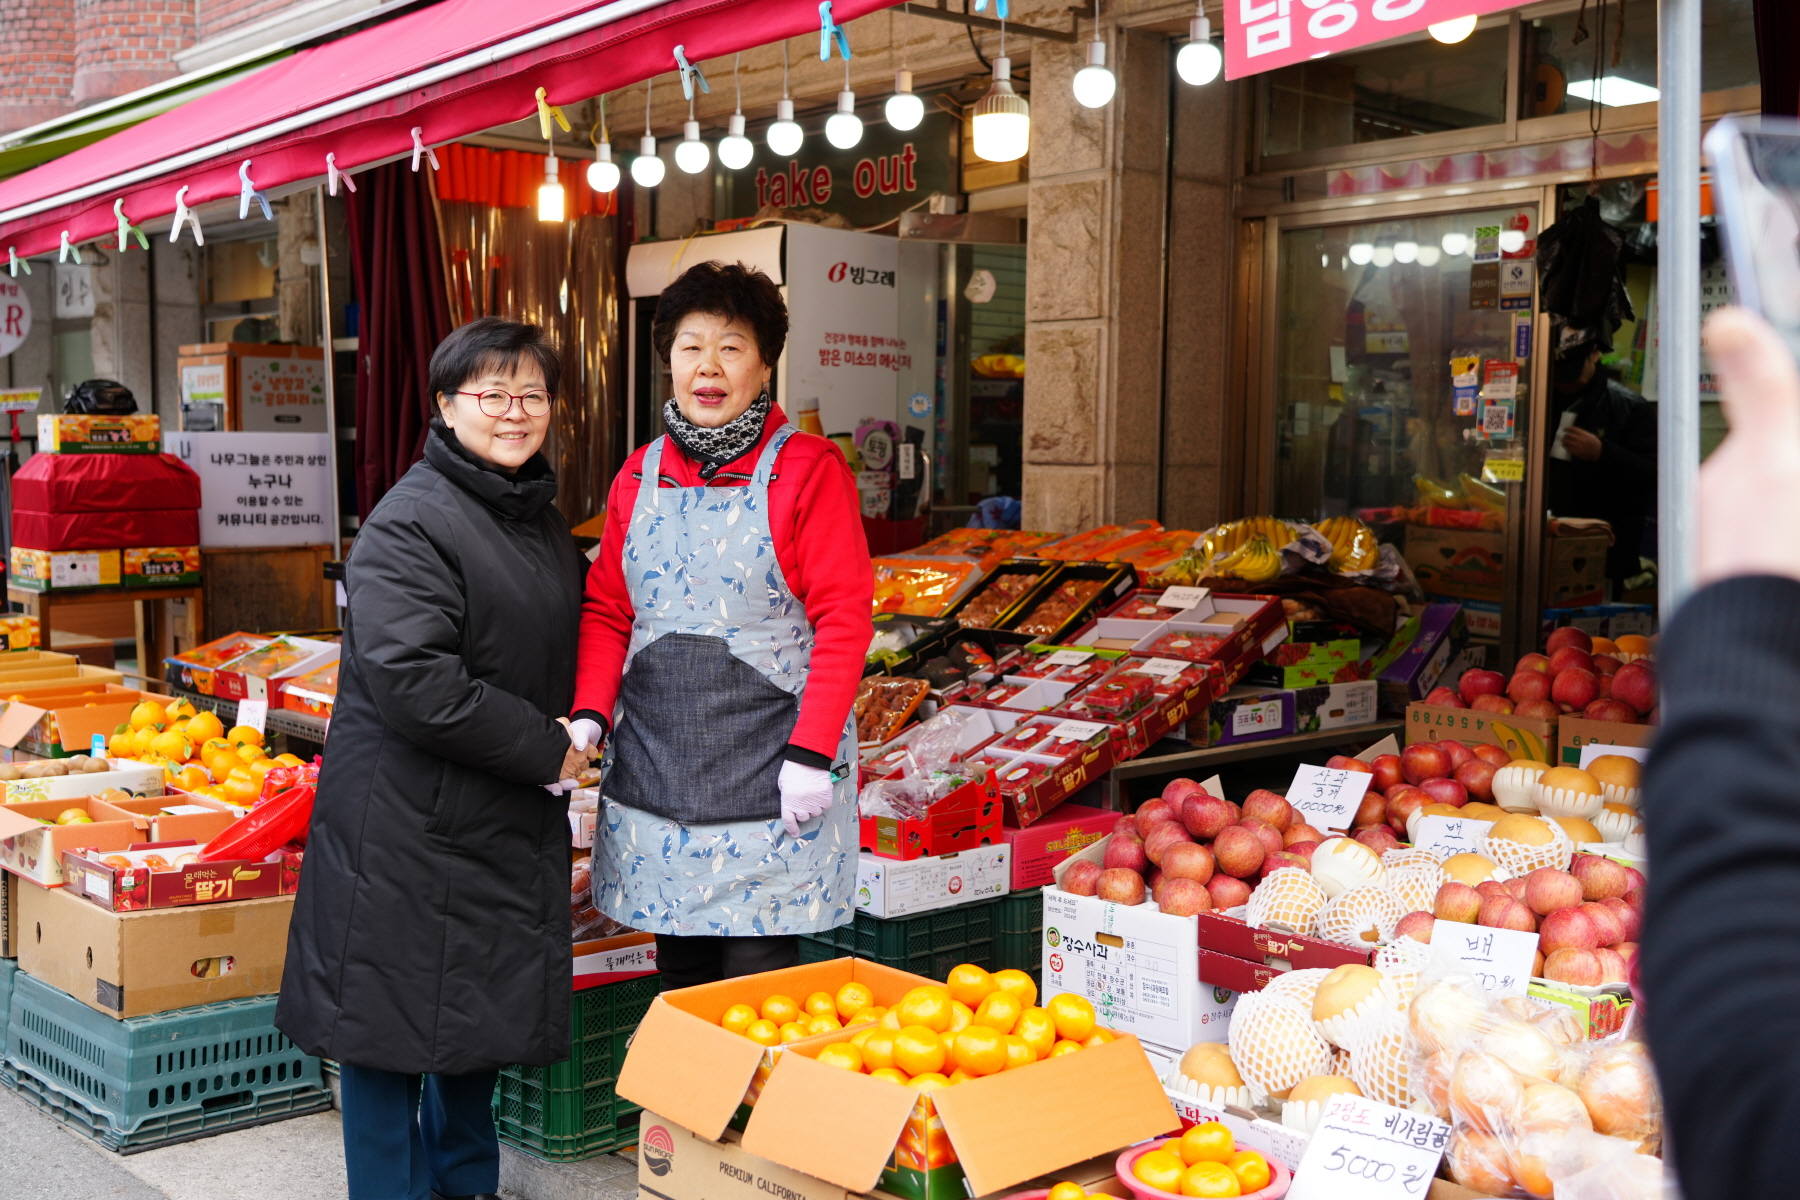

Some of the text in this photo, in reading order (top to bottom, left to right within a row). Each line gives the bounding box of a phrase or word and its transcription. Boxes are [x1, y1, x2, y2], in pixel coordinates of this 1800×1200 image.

[755, 142, 917, 208] take out
[850, 266, 895, 288] 빙그레
[819, 348, 912, 372] 밝은 미소의 메신저
[268, 377, 304, 391] 냉장고
[265, 392, 310, 407] 공유하러
[868, 436, 887, 458] 토핑
[211, 453, 327, 467] 나무그늘은 주민과 상인
[249, 473, 292, 489] 누구나
[237, 496, 303, 507] 이용할 수 있는
[217, 513, 324, 526] 커뮤니티 공간입니다.
[1167, 701, 1189, 727] 딸기
[1061, 764, 1087, 794] 딸기
[1446, 820, 1463, 836] 배
[184, 869, 218, 884] 몰래먹는
[195, 878, 233, 901] 딸기
[1062, 935, 1108, 960] 장수사과
[1267, 940, 1288, 956] 딸기
[1466, 933, 1494, 956] 배
[605, 951, 645, 971] 몰래먹는
[1325, 1101, 1371, 1126] 고당도
[654, 1146, 675, 1162] PACIFIC
[719, 1161, 753, 1185] PREMIUM
